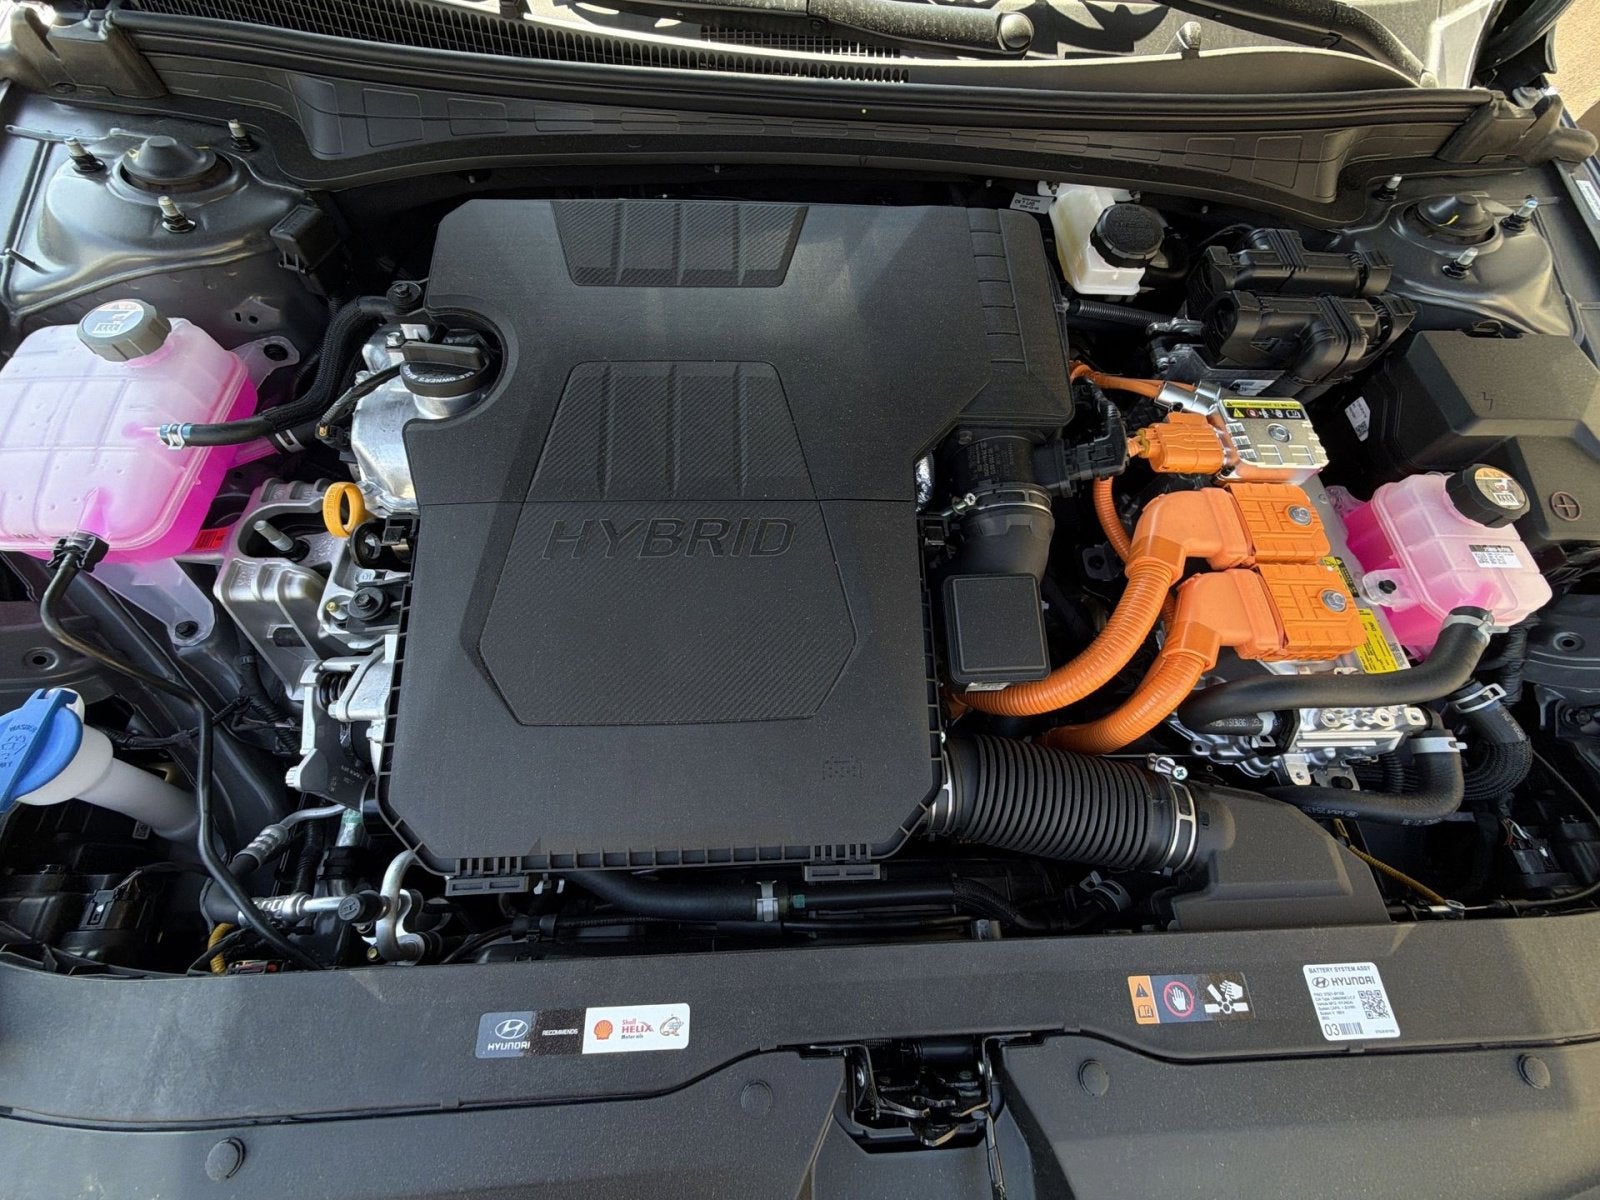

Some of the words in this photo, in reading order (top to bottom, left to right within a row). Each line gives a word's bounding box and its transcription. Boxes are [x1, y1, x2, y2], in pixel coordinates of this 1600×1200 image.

[542, 517, 796, 560] HYBRID
[1330, 976, 1376, 986] HYUNDAI
[622, 1024, 652, 1034] HELIX
[1324, 1023, 1340, 1036] 03
[487, 1041, 531, 1051] HYUNDAI
